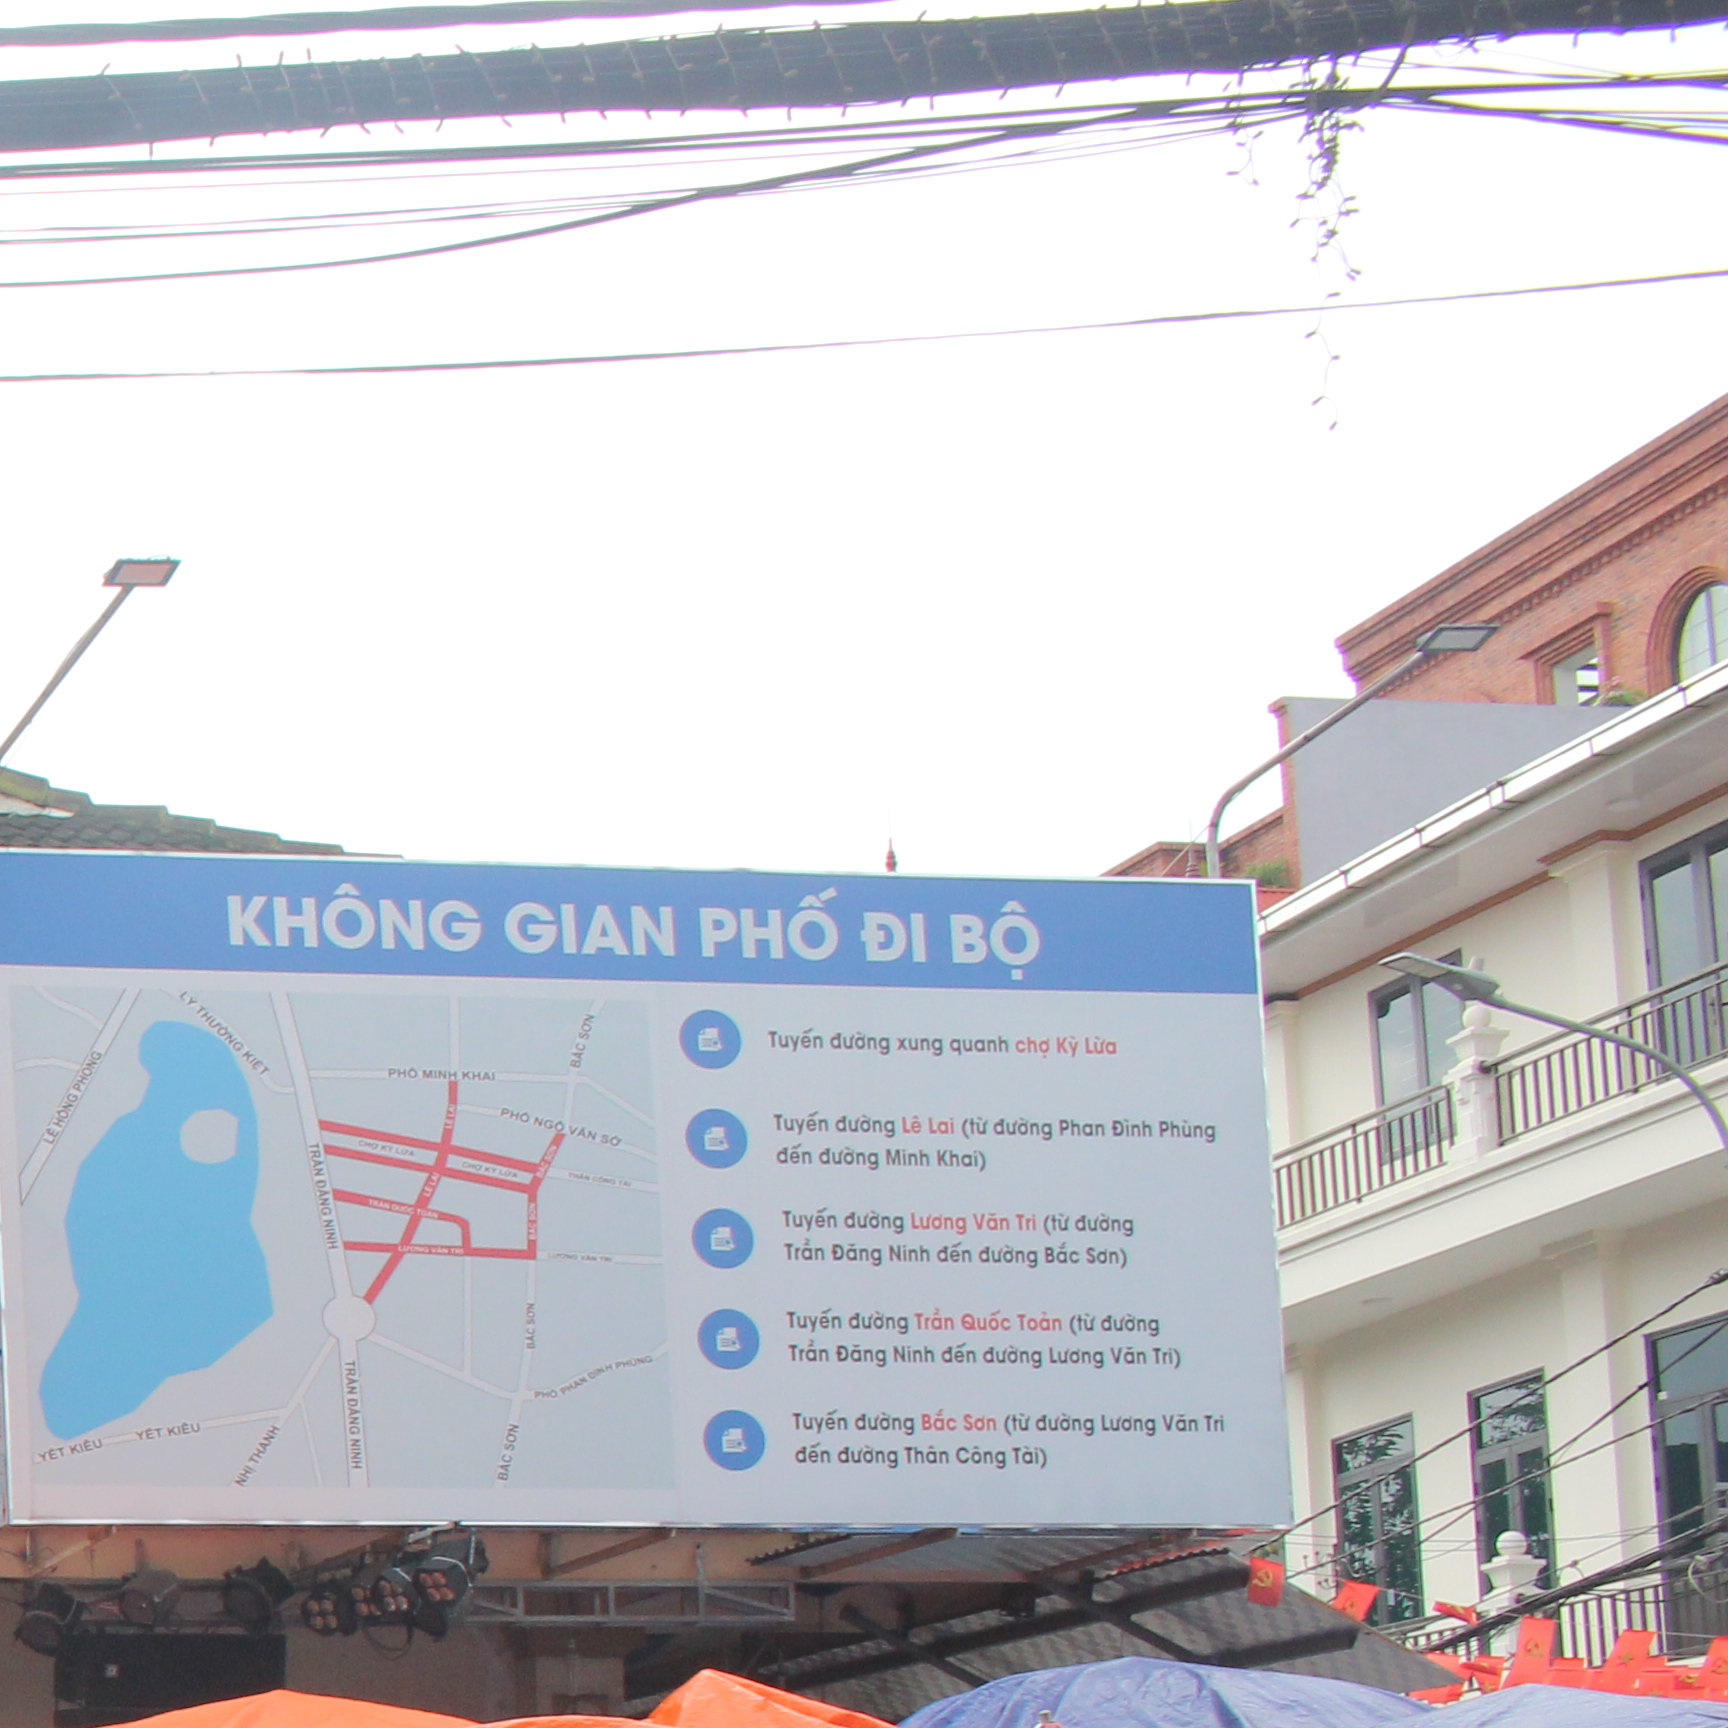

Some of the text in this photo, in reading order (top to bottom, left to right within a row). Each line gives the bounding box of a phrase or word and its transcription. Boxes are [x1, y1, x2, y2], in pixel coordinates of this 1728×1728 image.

[227, 884, 1040, 981] KHÔNG GIAN PHỐ ĐI BỘ
[768, 1028, 1117, 1058] Tuyến đường xung quanh chợ Kỳ Lừa
[773, 1111, 1216, 1143] Tuyến đường Lê Lai (từ đường Phan Đình Phùng
[776, 1143, 986, 1172] đến đường Minh Khai)
[782, 1207, 1134, 1237] Tuyến đường Lương Văn Tri (từ đường
[784, 1238, 1127, 1269] Trần Đăng Ninh đến đường Bắc Sơn)
[786, 1308, 1159, 1337] Tuyến đường Trần Quốc Toản (từ đường
[788, 1339, 1181, 1369] Trần Đăng Ninh đến đường Lương Văn Tri)
[792, 1409, 1225, 1437] Tuyến đường Bắc Sơn (từ đường Lương Văn Tri
[795, 1443, 1047, 1469] đến đường Thân Công Tài)
